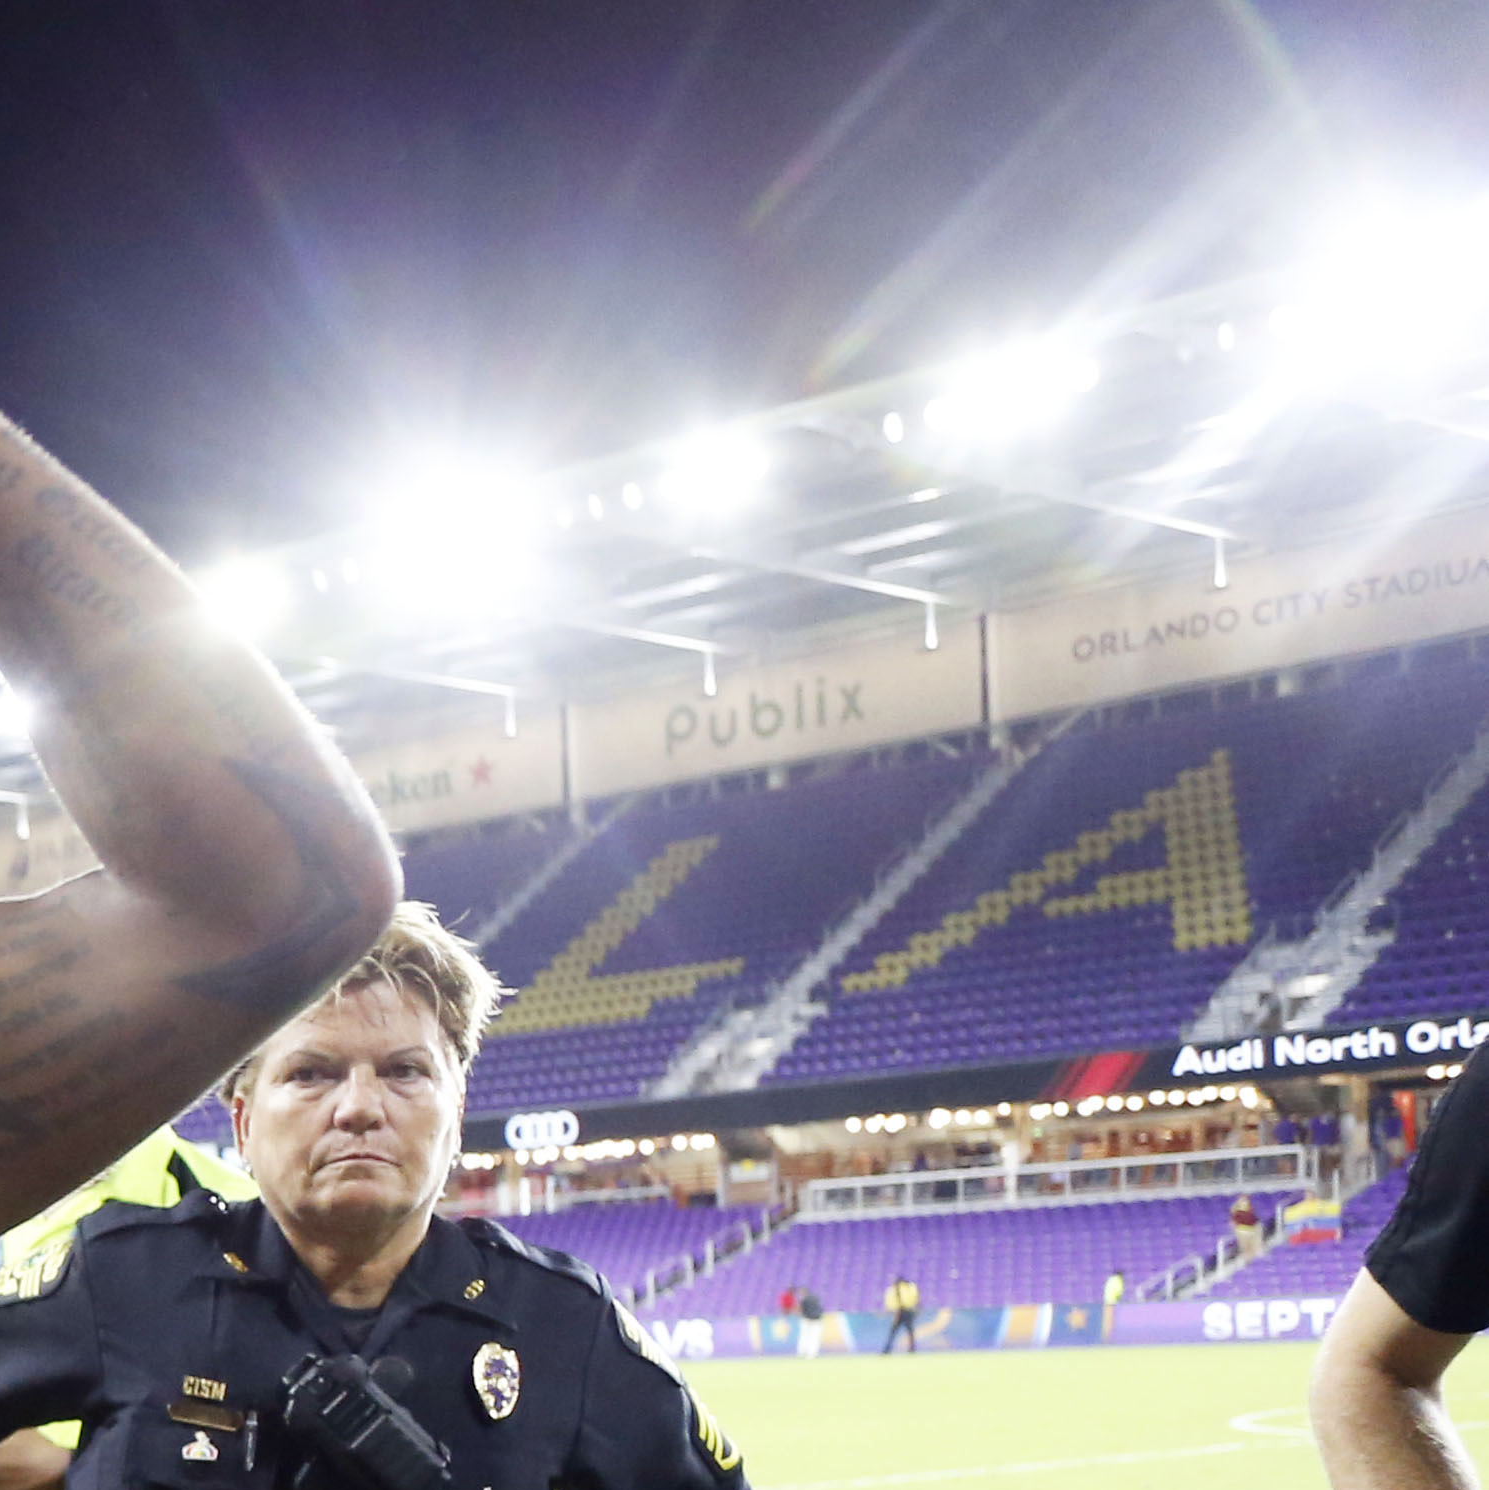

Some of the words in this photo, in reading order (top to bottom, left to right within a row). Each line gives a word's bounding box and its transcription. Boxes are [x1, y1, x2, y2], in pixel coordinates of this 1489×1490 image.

[1071, 605, 1240, 663] ORLANDO
[1252, 588, 1330, 627] CITY
[1171, 1037, 1265, 1078] Audi
[1273, 1026, 1398, 1067] North
[1202, 1297, 1336, 1341] SEPT
